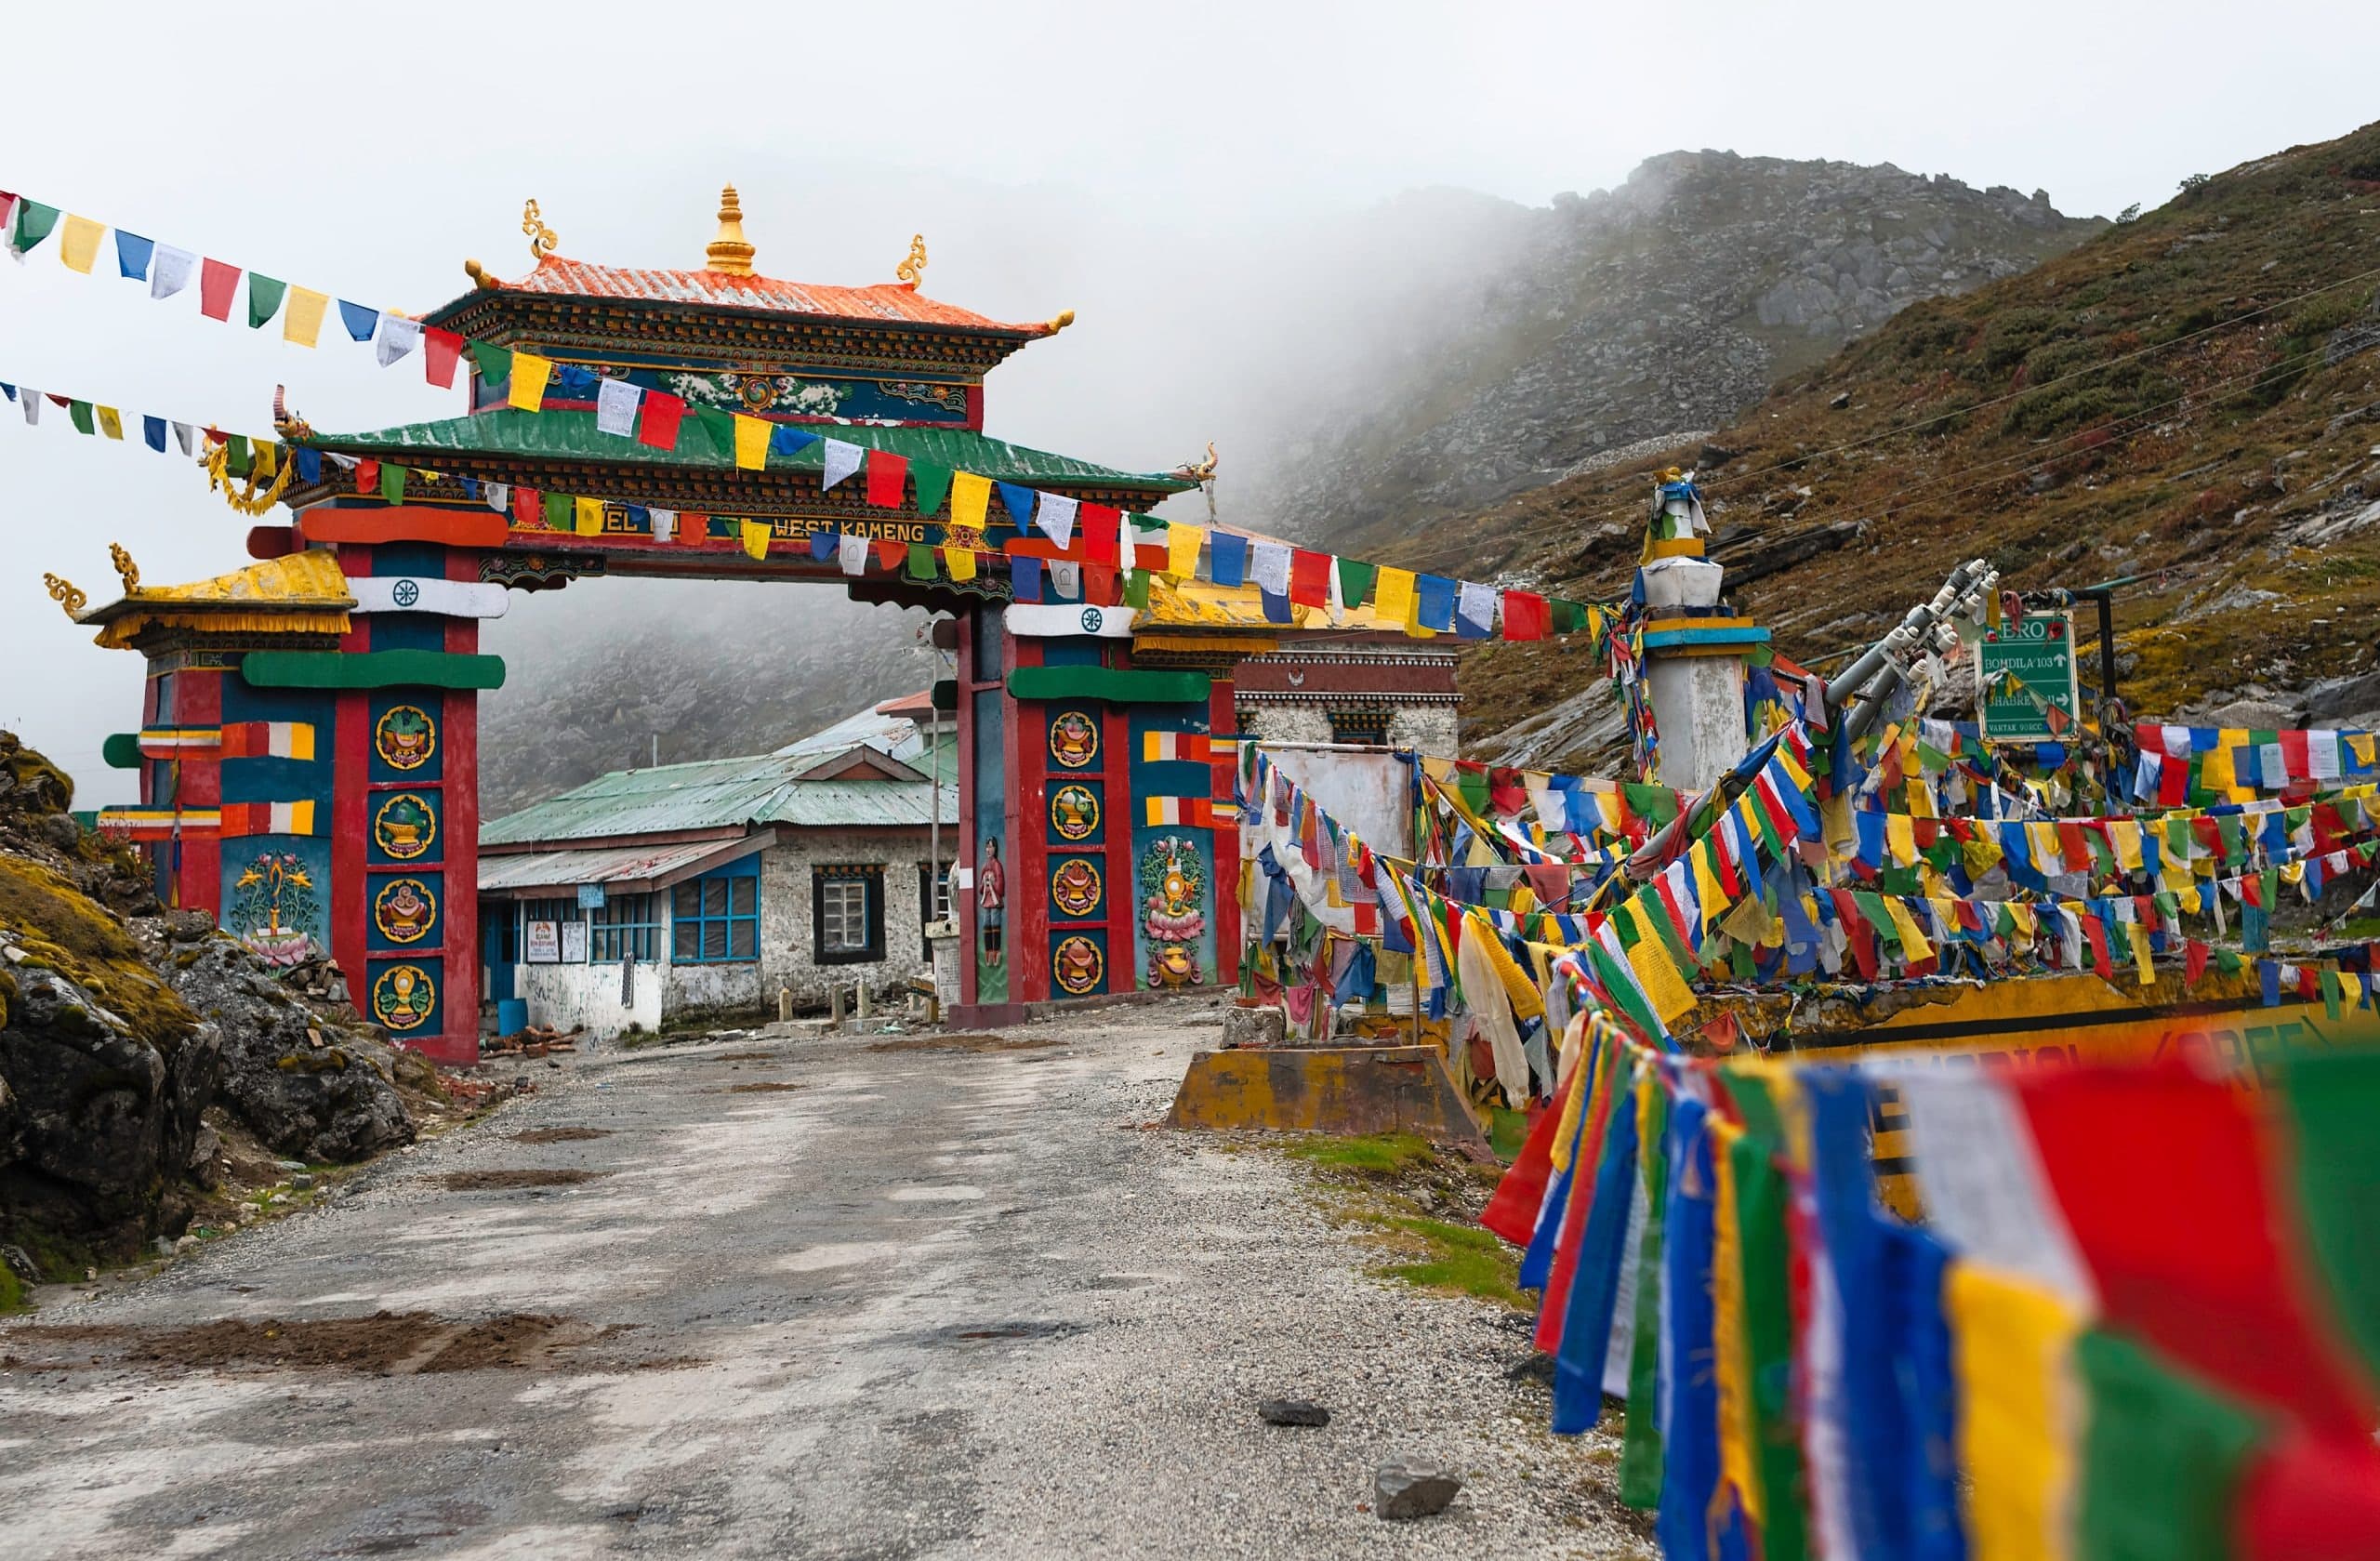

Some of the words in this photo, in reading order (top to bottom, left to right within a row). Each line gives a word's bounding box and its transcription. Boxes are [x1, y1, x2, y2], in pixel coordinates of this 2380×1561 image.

[774, 518, 834, 538] WEST
[840, 521, 925, 542] KAMENG
[2037, 656, 2054, 668] 103
